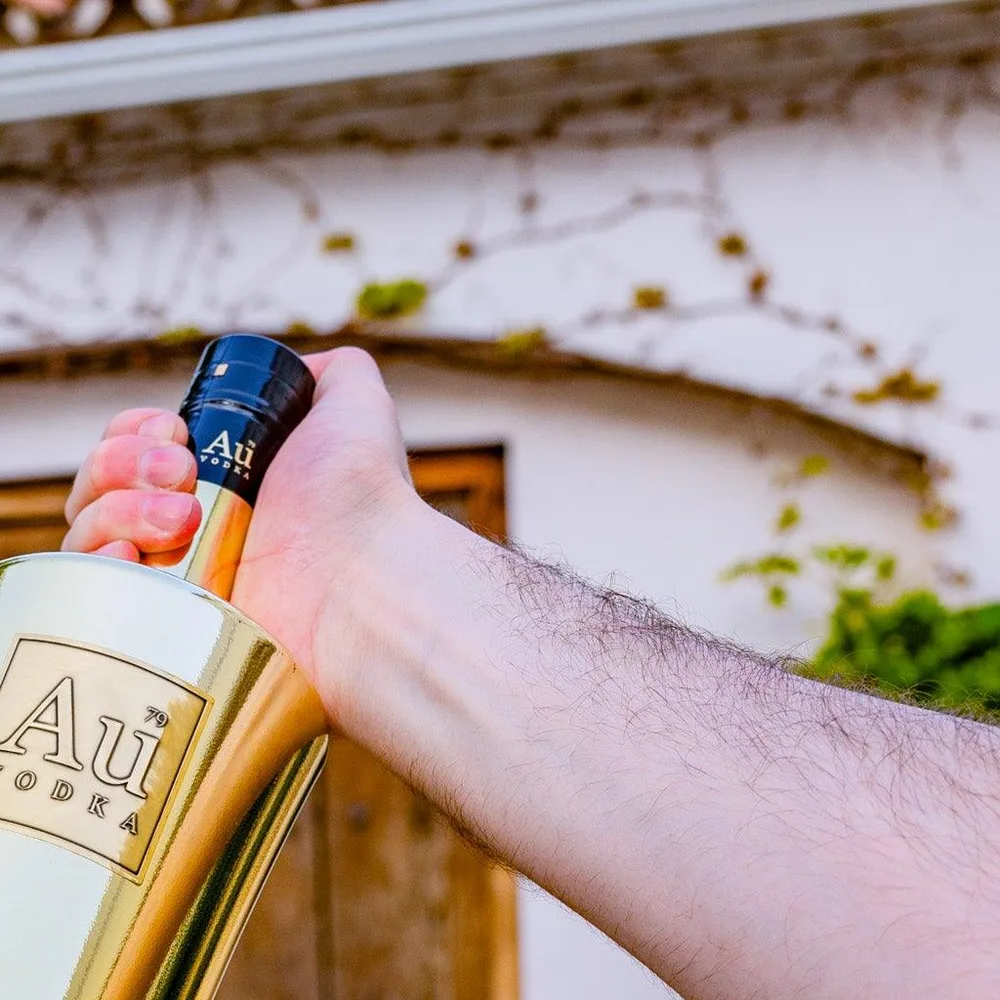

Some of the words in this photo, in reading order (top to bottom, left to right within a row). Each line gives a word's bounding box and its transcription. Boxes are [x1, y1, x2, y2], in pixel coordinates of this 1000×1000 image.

[201, 430, 255, 470] Au
[199, 454, 250, 480] VODKA
[145, 706, 169, 727] 79
